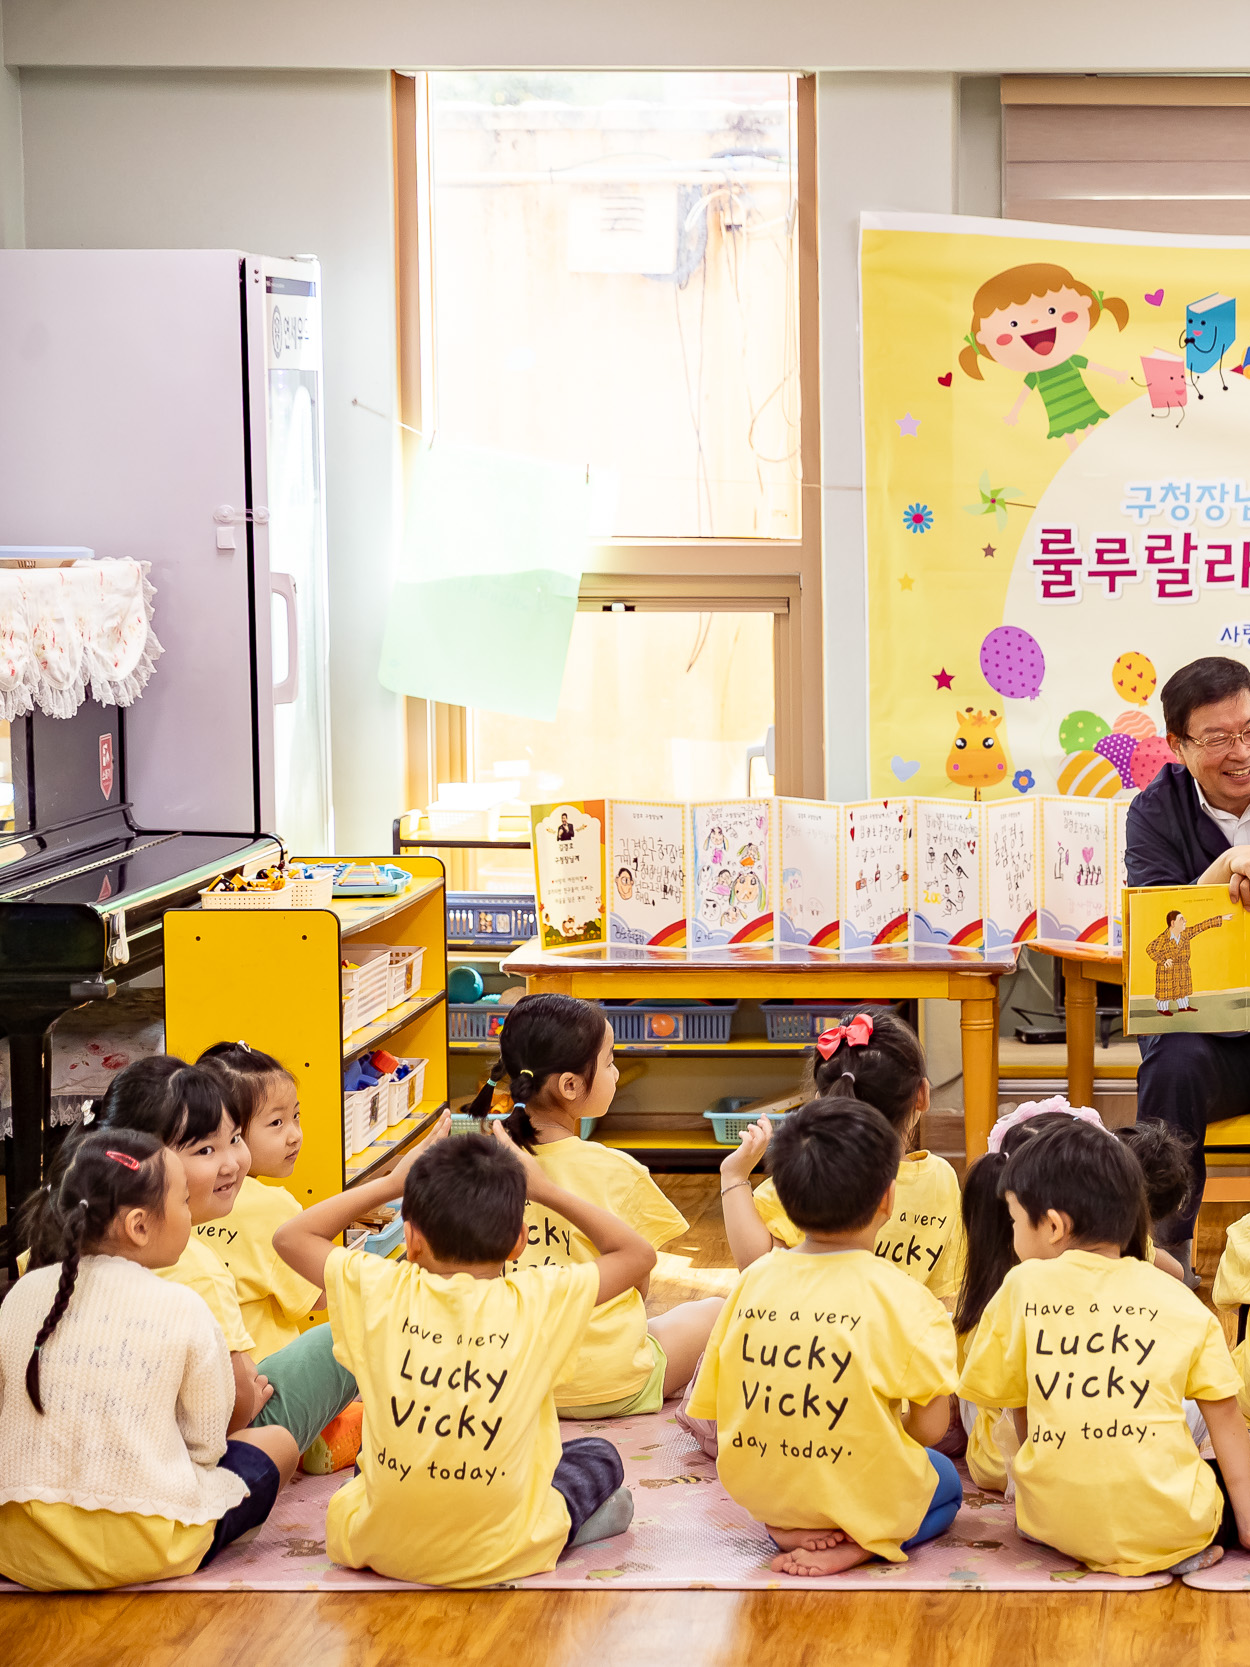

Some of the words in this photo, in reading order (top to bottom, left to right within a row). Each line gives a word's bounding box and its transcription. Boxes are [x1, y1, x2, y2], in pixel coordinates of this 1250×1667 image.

[197, 1225, 238, 1245] very
[527, 1216, 571, 1256] cky
[900, 1211, 907, 1222] a
[914, 1213, 948, 1229] very
[875, 1234, 944, 1272] ucky
[790, 1310, 800, 1321] a
[814, 1311, 862, 1331] very
[1025, 1302, 1075, 1317] Have
[1089, 1303, 1100, 1313] a
[1112, 1305, 1158, 1322] very
[742, 1332, 852, 1384] Lucky
[1036, 1323, 1156, 1366] Lucky
[400, 1349, 508, 1404] Lucky
[1034, 1366, 1150, 1409] Vicky
[390, 1396, 503, 1451] Vicky
[742, 1380, 849, 1431] Vicky
[732, 1431, 768, 1458] day
[780, 1438, 852, 1465] today.
[1032, 1424, 1067, 1450] day
[1081, 1418, 1156, 1444] today.
[377, 1447, 412, 1482] day
[427, 1461, 506, 1487] today.
